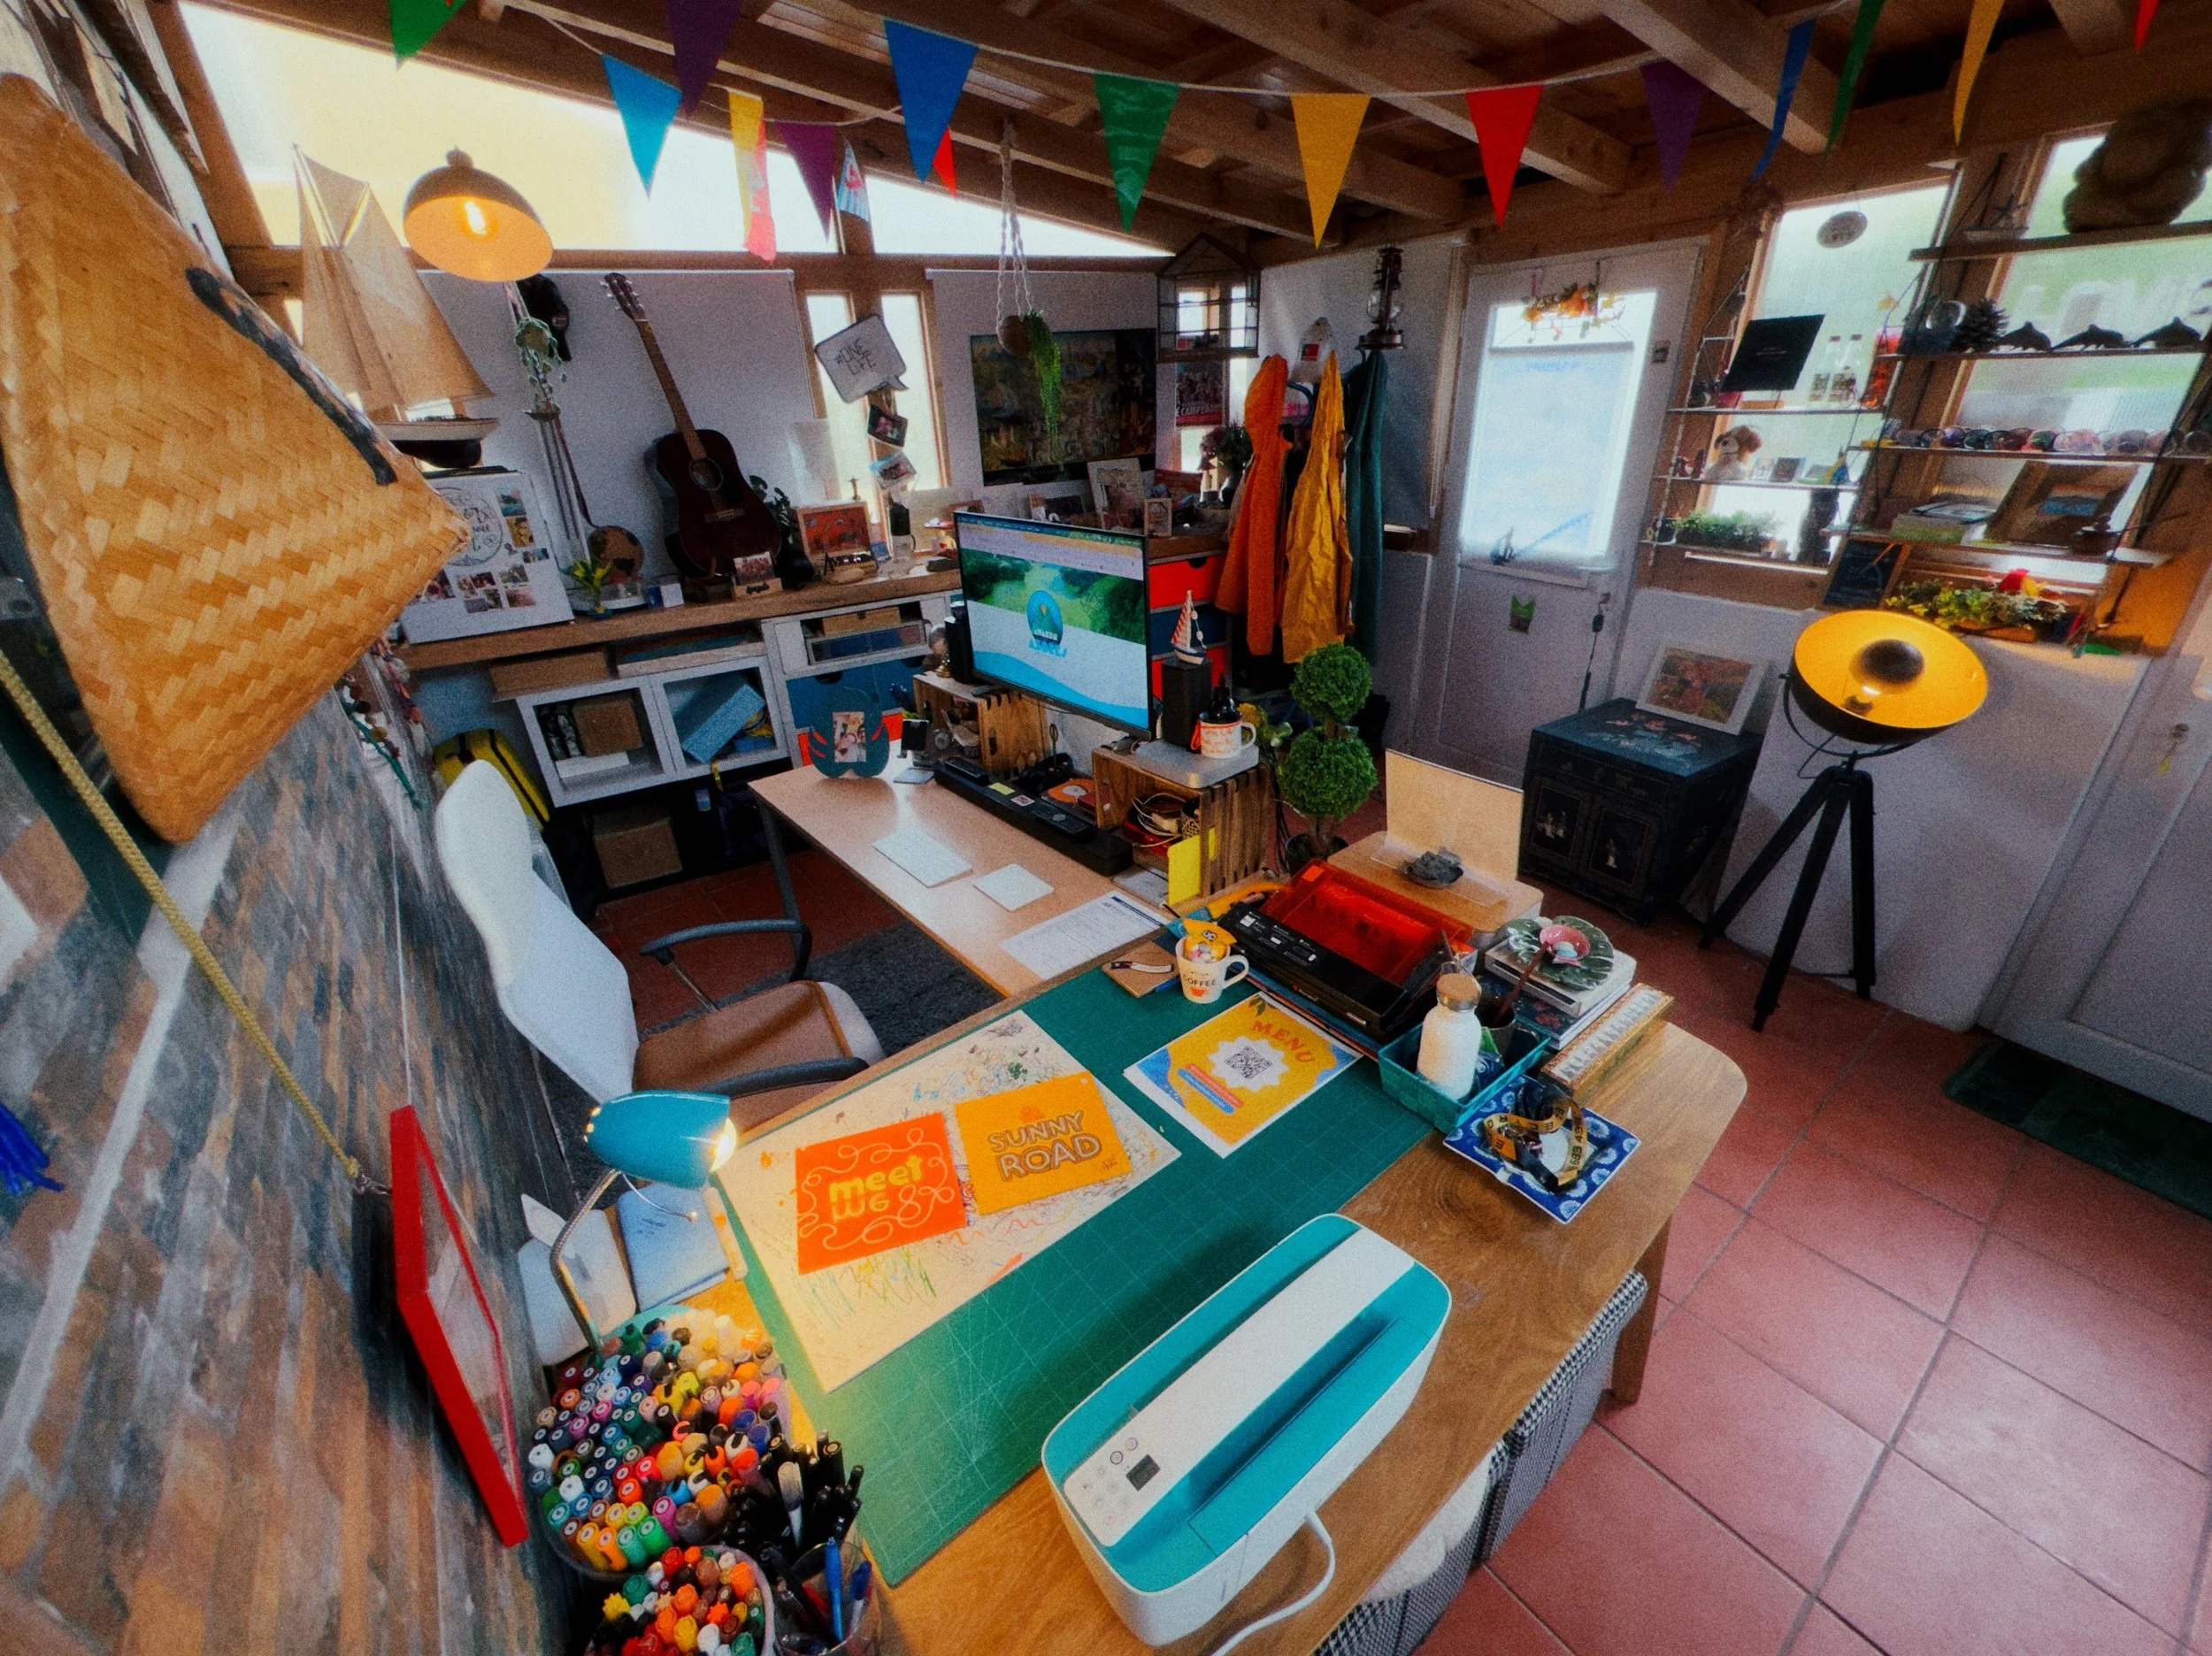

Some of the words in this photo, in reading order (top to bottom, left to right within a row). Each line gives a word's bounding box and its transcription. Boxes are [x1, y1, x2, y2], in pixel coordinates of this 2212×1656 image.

[1183, 974, 1217, 987] COFFEE
[1250, 1020, 1316, 1062] MENU
[987, 1109, 1084, 1153] SUNNY
[829, 1154, 924, 1203] meet
[996, 1132, 1102, 1183] ROAD
